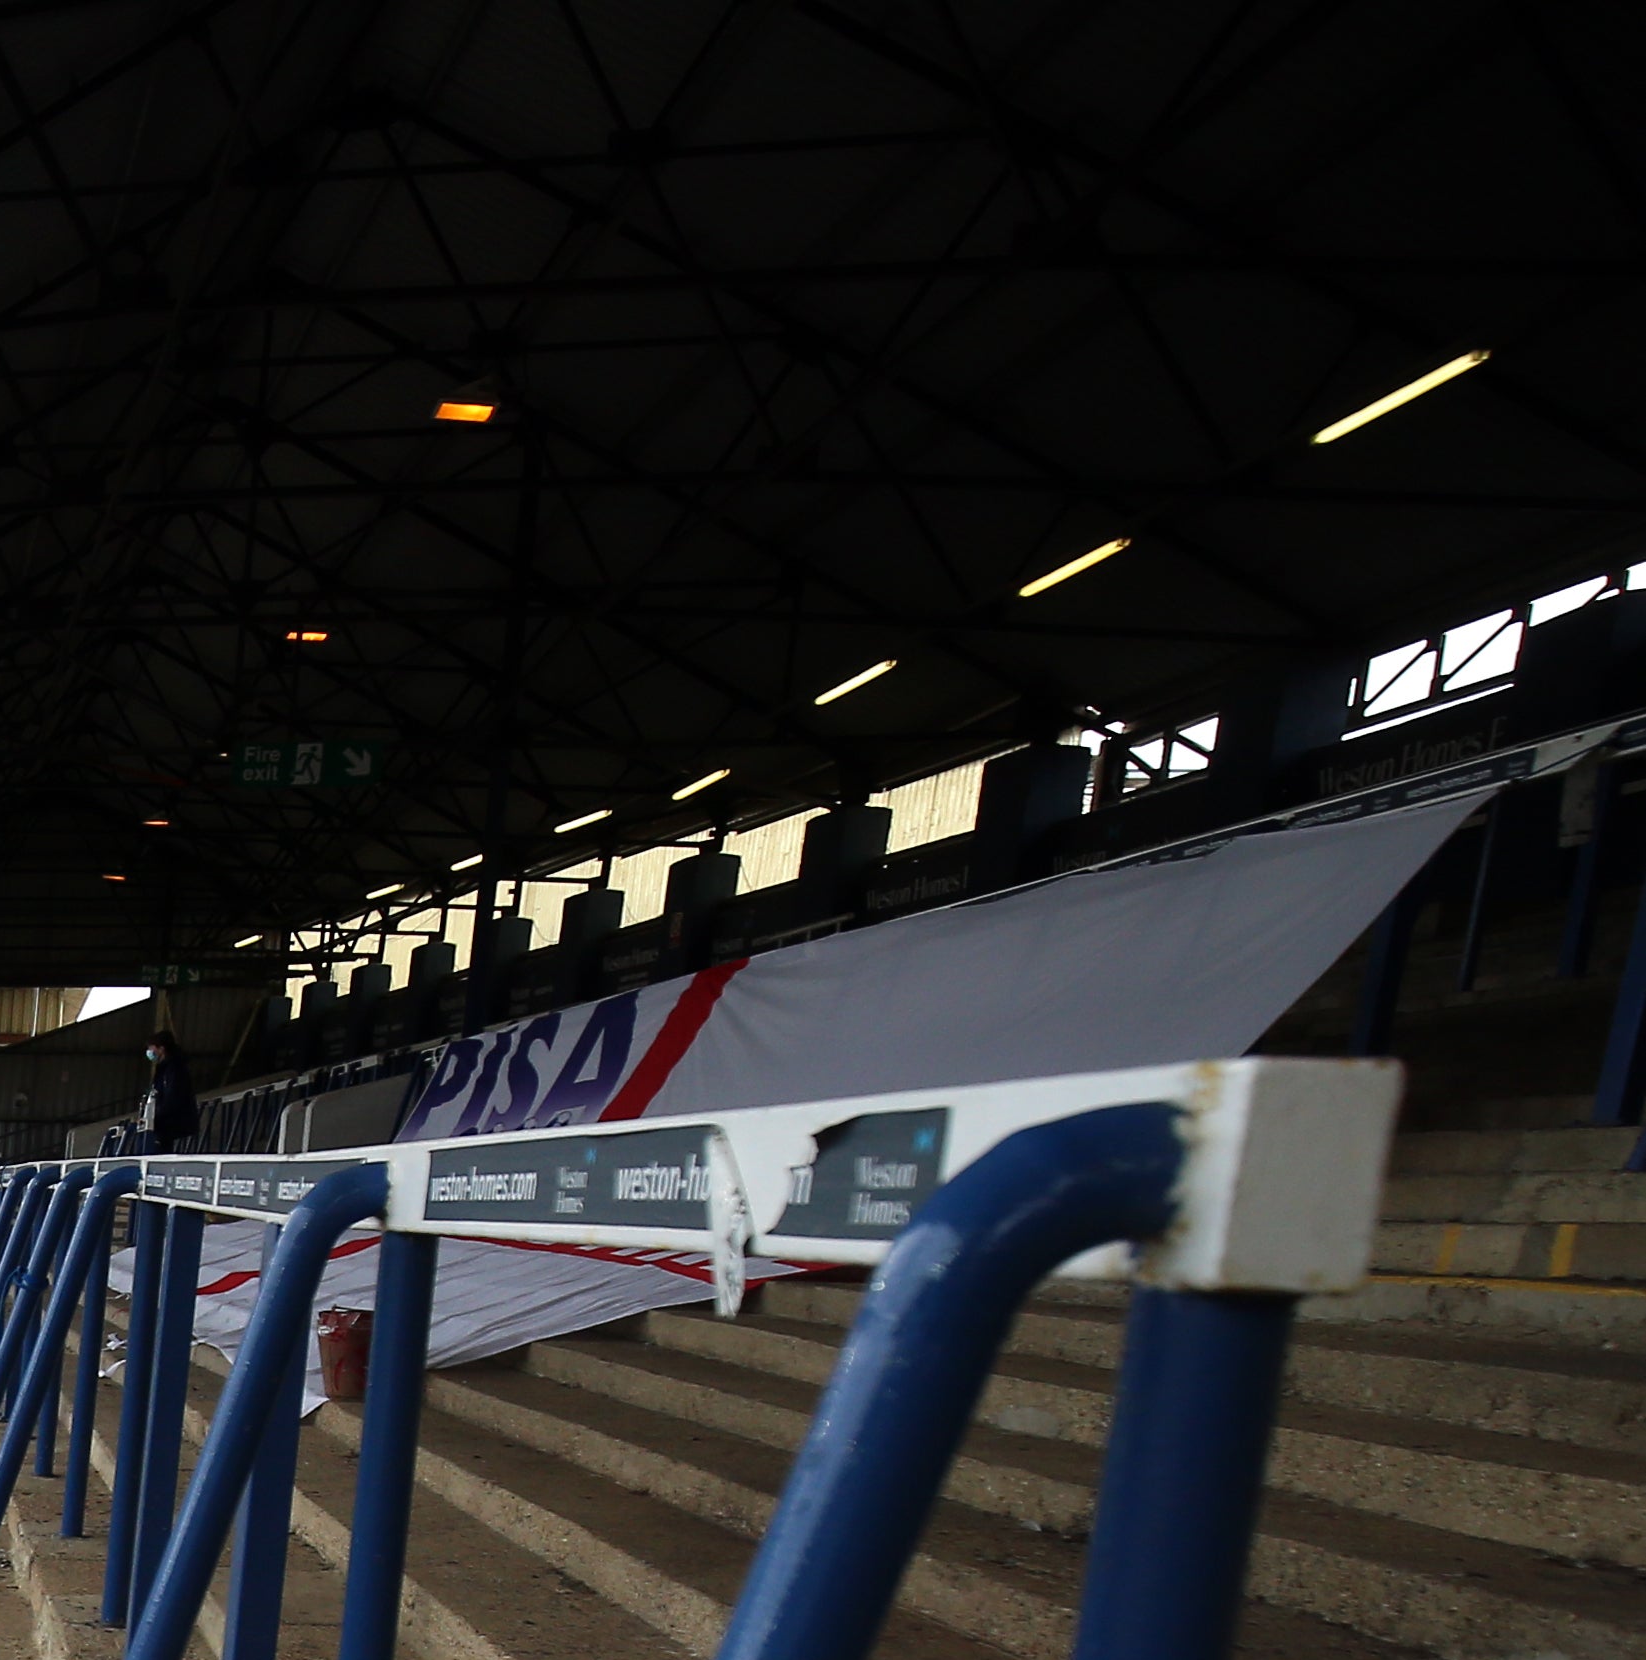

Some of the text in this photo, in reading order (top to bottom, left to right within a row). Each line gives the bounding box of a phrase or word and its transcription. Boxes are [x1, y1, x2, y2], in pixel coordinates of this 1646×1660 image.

[243, 746, 281, 763] Fire
[242, 766, 279, 782] exit
[431, 1166, 537, 1203] weston-homes.com
[557, 1166, 589, 1190] Weston
[854, 1155, 918, 1191] Weston
[556, 1192, 585, 1215] Homes
